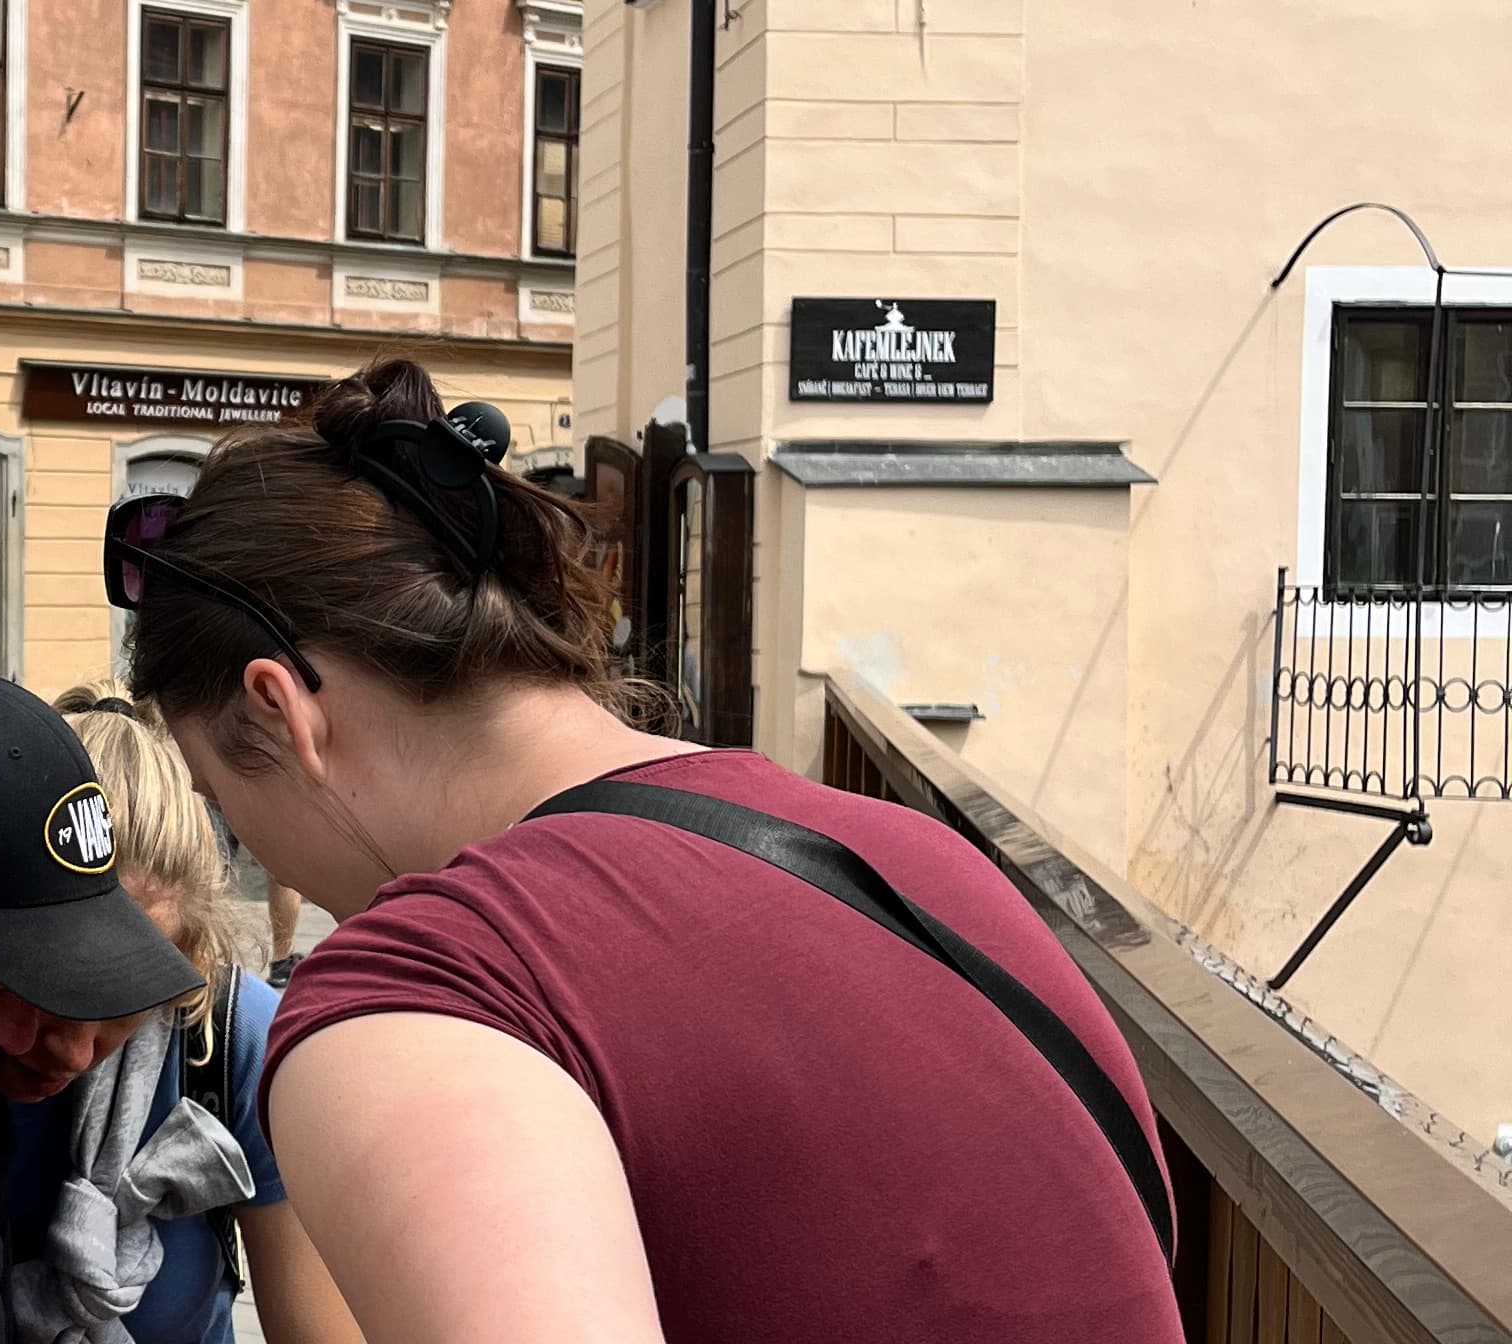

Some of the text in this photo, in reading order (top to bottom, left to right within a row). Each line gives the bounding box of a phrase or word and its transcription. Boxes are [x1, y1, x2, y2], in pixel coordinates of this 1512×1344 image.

[832, 329, 956, 362] KAFEMLEJNEK
[181, 378, 302, 407] Moldavite
[86, 401, 281, 423] LOCAL TRADITIONAL JEWELLERY
[68, 794, 112, 863] VANS
